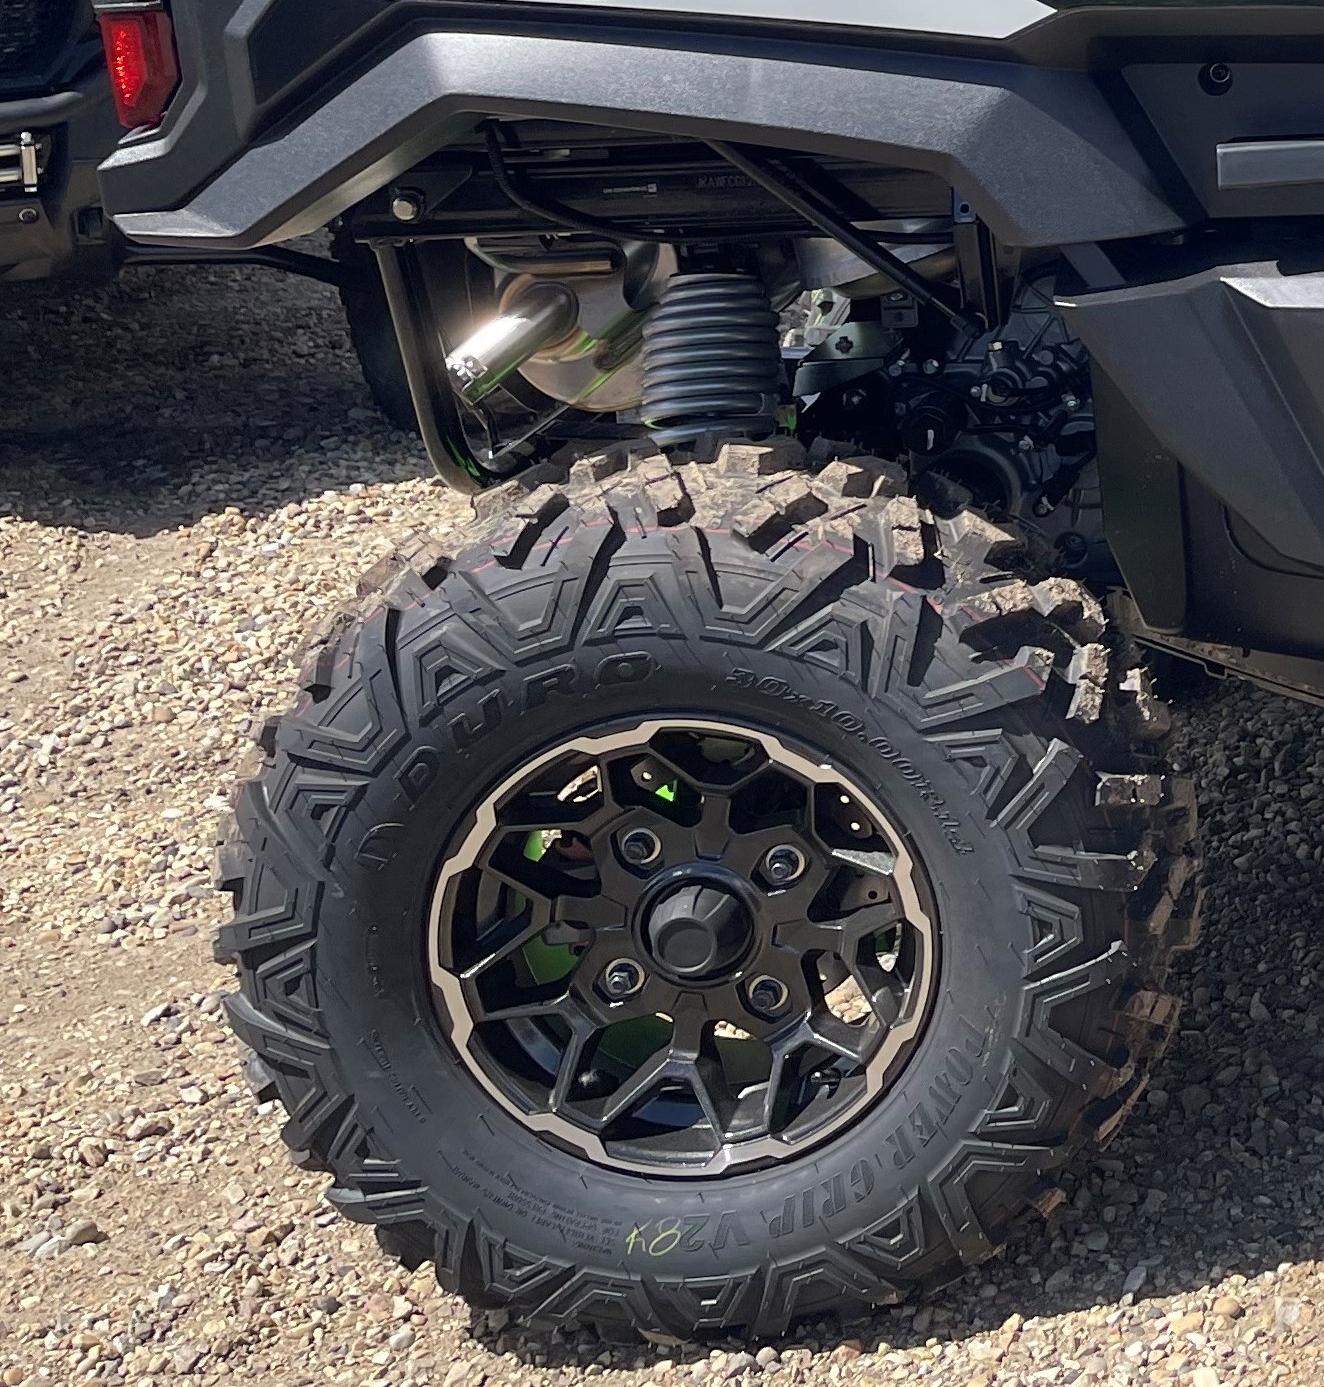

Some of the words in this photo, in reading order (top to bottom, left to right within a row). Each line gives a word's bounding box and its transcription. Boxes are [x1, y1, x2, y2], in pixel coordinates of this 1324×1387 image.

[394, 649, 663, 811] DURO
[882, 1014, 989, 1170] POWER
[767, 1158, 876, 1239] GRIP
